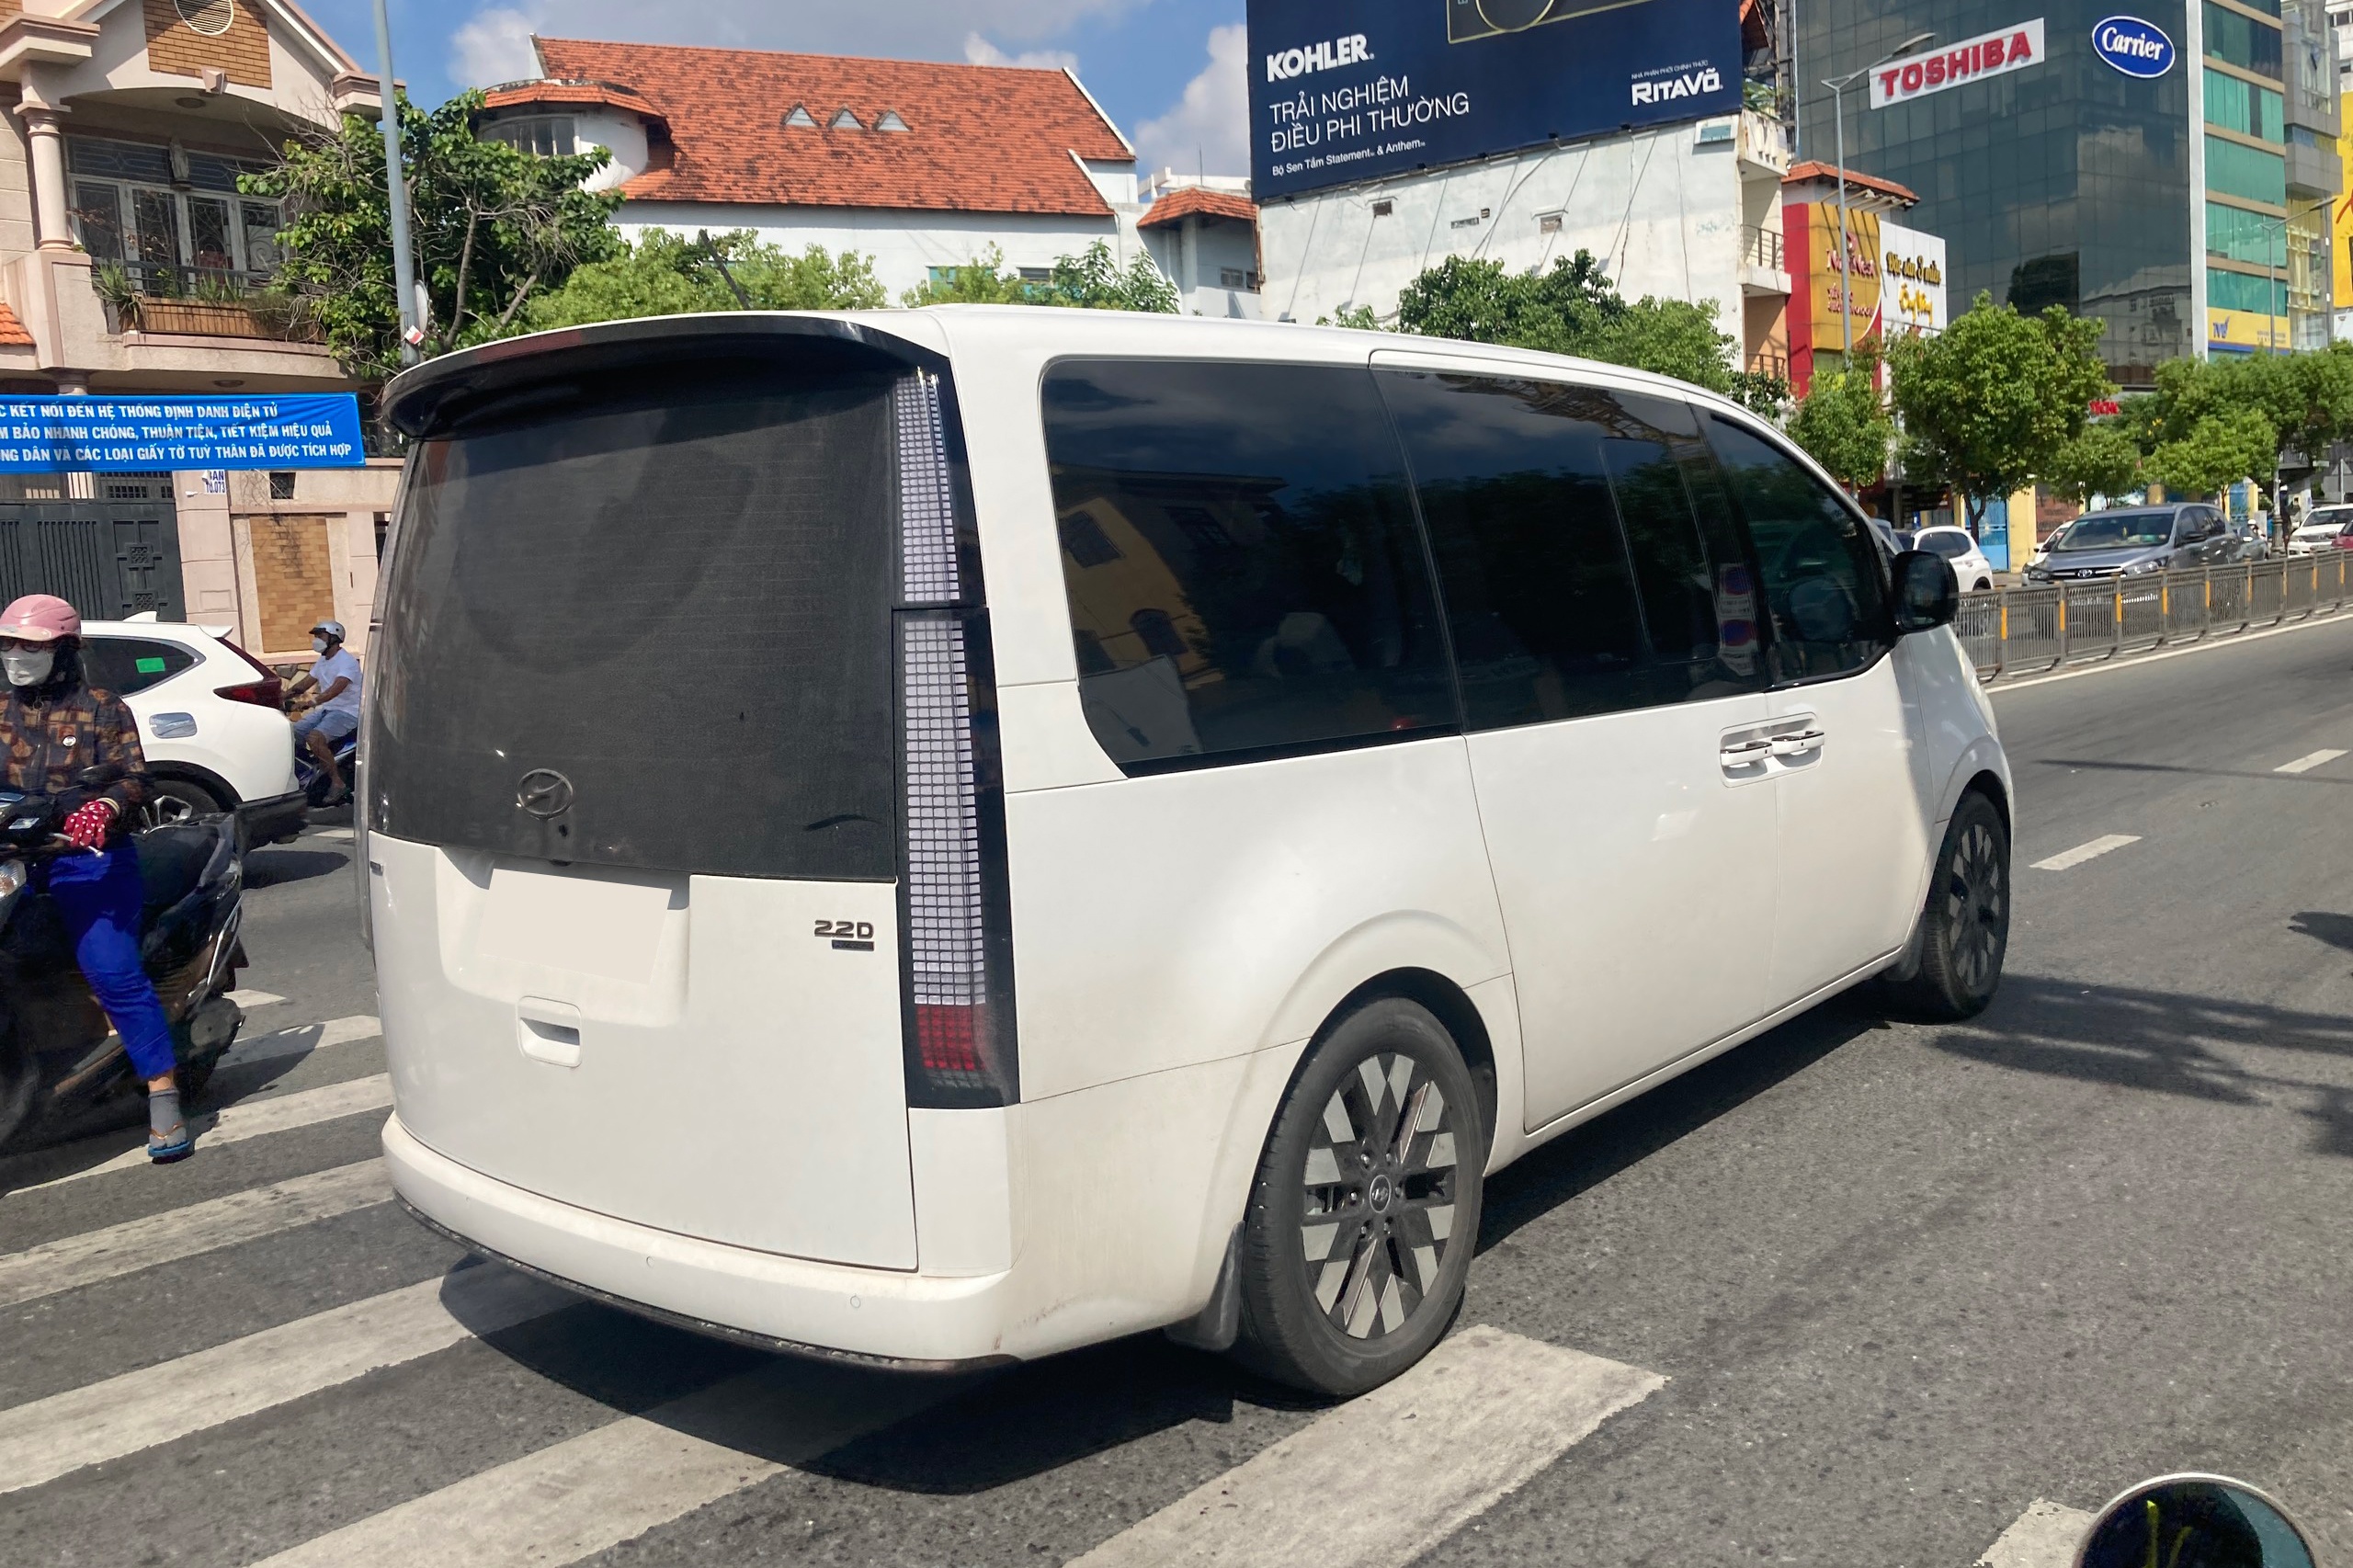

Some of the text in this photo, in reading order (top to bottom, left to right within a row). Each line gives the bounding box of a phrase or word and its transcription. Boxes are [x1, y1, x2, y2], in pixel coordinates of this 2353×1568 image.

[2101, 26, 2165, 61] Carrier
[1880, 30, 2033, 97] TOSHIBA
[1269, 75, 1409, 125] TRẢI NGHIỆM
[1271, 92, 1470, 153] ĐIỀU PHI THƯỜNG
[1272, 165, 1285, 177] Bộ
[1286, 162, 1303, 173] Sen
[1376, 144, 1384, 156] &
[9, 401, 36, 418] KẾT
[40, 401, 64, 418] NỐI
[67, 401, 95, 418] ĐẾN
[97, 403, 115, 420] HỆ
[119, 402, 161, 418] THỐNG
[165, 405, 194, 421] ĐỊNH
[197, 405, 229, 418] DANH
[232, 404, 260, 420] ĐIỆN
[262, 402, 278, 417] TỬ
[12, 422, 40, 439] BẢO
[44, 426, 88, 439] NHANH
[92, 424, 139, 441] CHÓNG,
[142, 424, 182, 441] THUẬN
[186, 423, 218, 439] TIỆN,
[220, 422, 245, 438] TIẾT
[249, 423, 278, 439] KIỆM
[281, 422, 308, 438] HIỆU
[311, 420, 333, 437] QUẢ
[22, 446, 51, 461] DÂN
[53, 446, 72, 461] VÀ
[75, 445, 101, 461] CÁC
[105, 448, 133, 462] LOẠI
[137, 443, 165, 460] GIẤY
[167, 444, 185, 460] TỜ
[215, 445, 247, 459] THÂN
[249, 444, 266, 458] ĐÃ
[269, 445, 300, 460] ĐƯỢC
[301, 442, 326, 457] TÍCH
[329, 442, 351, 458] HỢP
